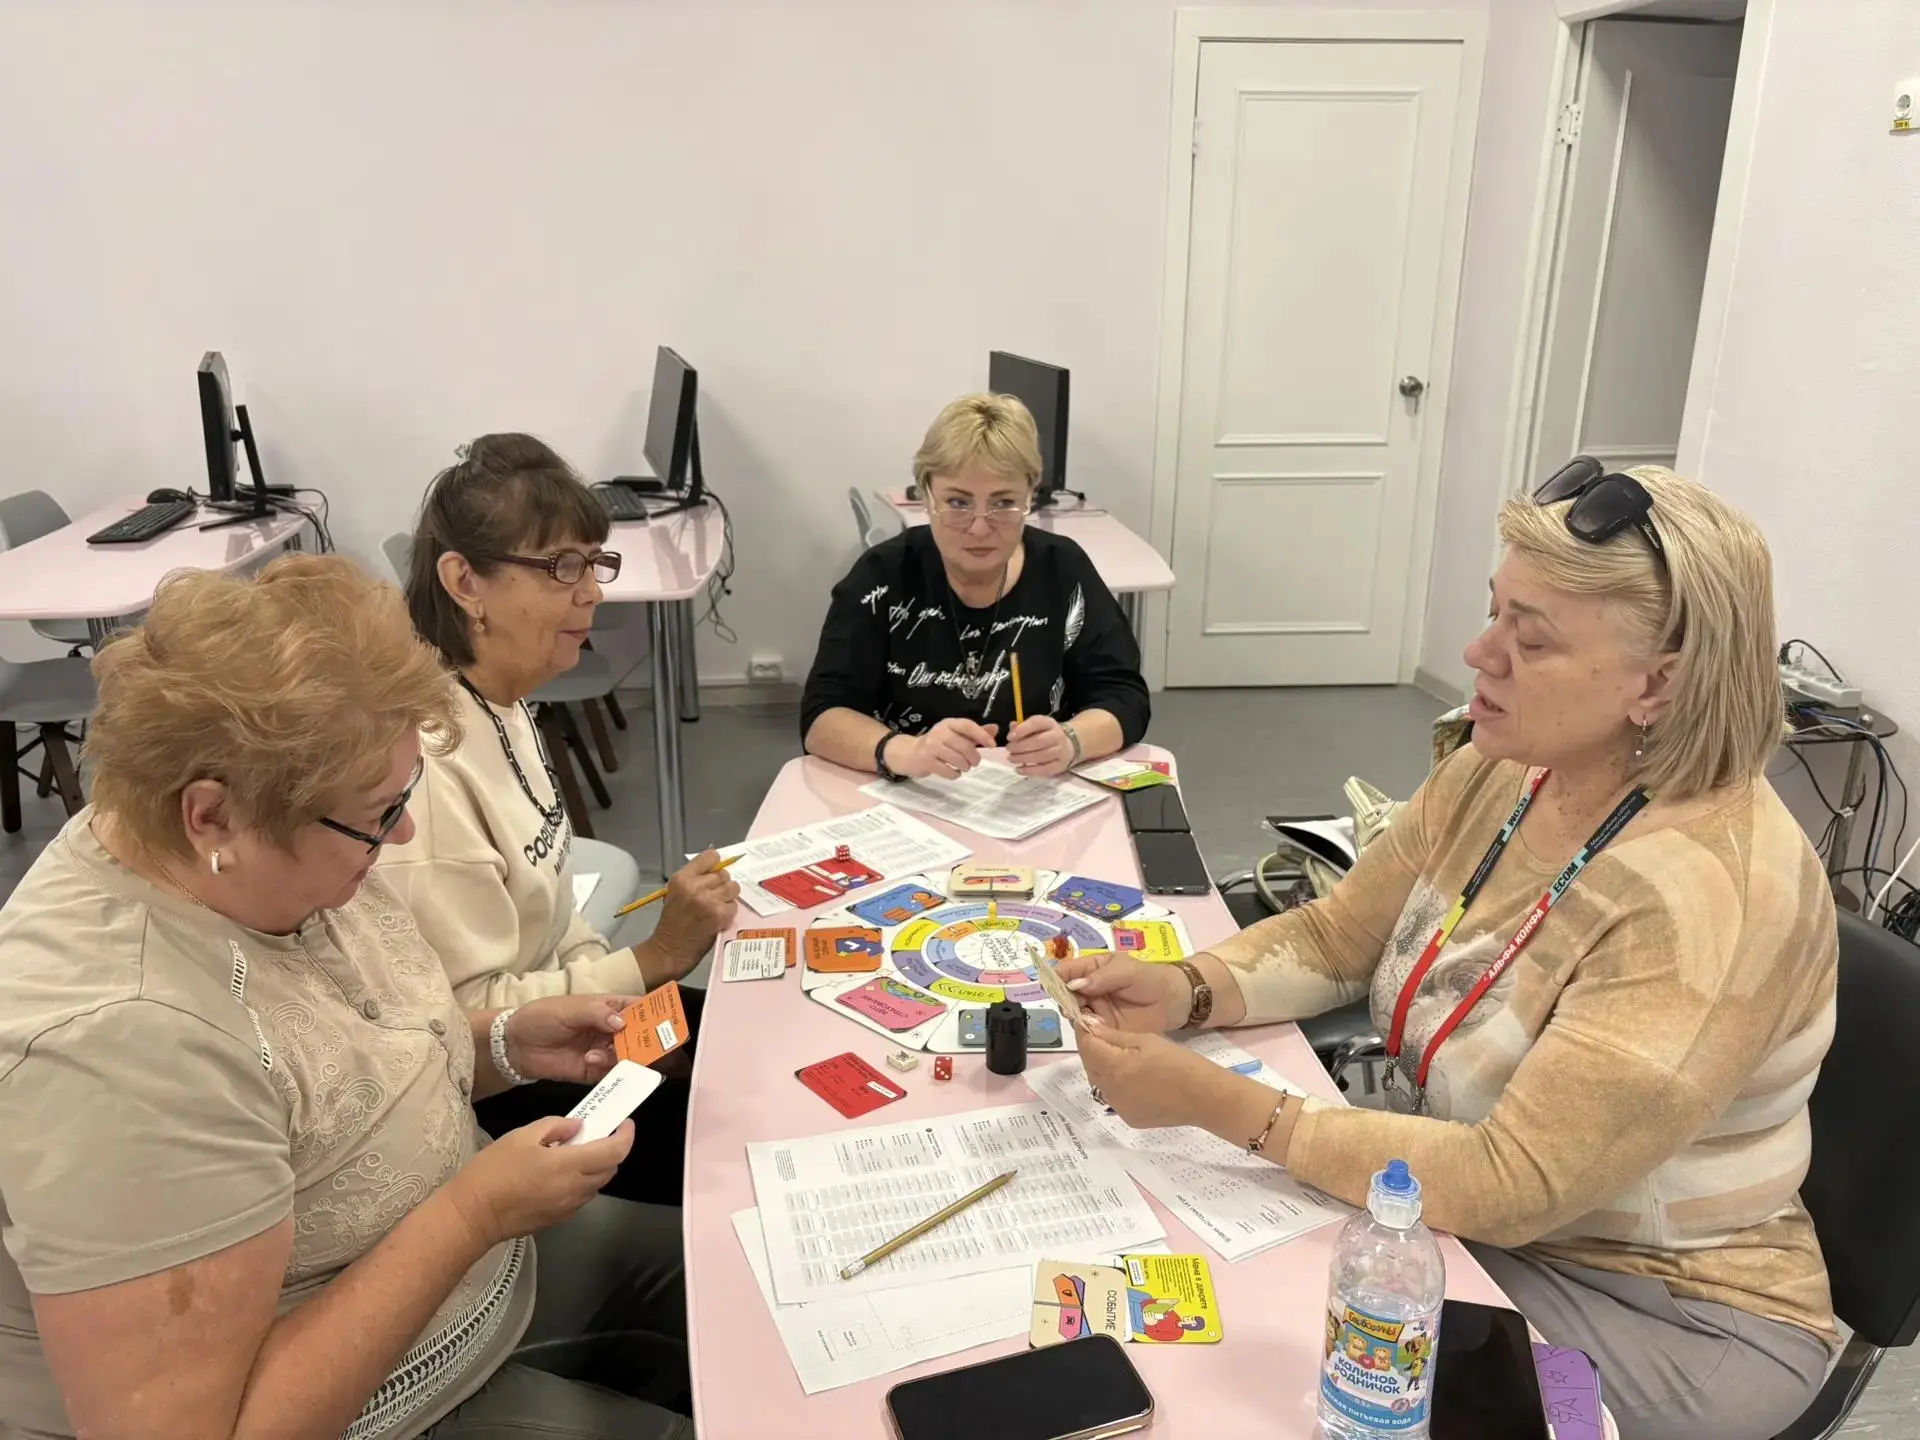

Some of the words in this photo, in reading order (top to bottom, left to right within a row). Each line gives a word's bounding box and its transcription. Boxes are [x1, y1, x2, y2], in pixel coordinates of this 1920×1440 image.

[1506, 797, 1528, 828] ECOM
[1552, 862, 1579, 894] ECOM
[1487, 943, 1517, 980] АЛЬФА
[1514, 907, 1545, 946] КОНФА
[1191, 1258, 1200, 1276] Мама
[1197, 1282, 1208, 1310] декрете
[1105, 1289, 1117, 1331] СОБЫТИЕ
[1333, 1365, 1401, 1395] РОДНИЧОК
[1391, 1414, 1412, 1425] вода
